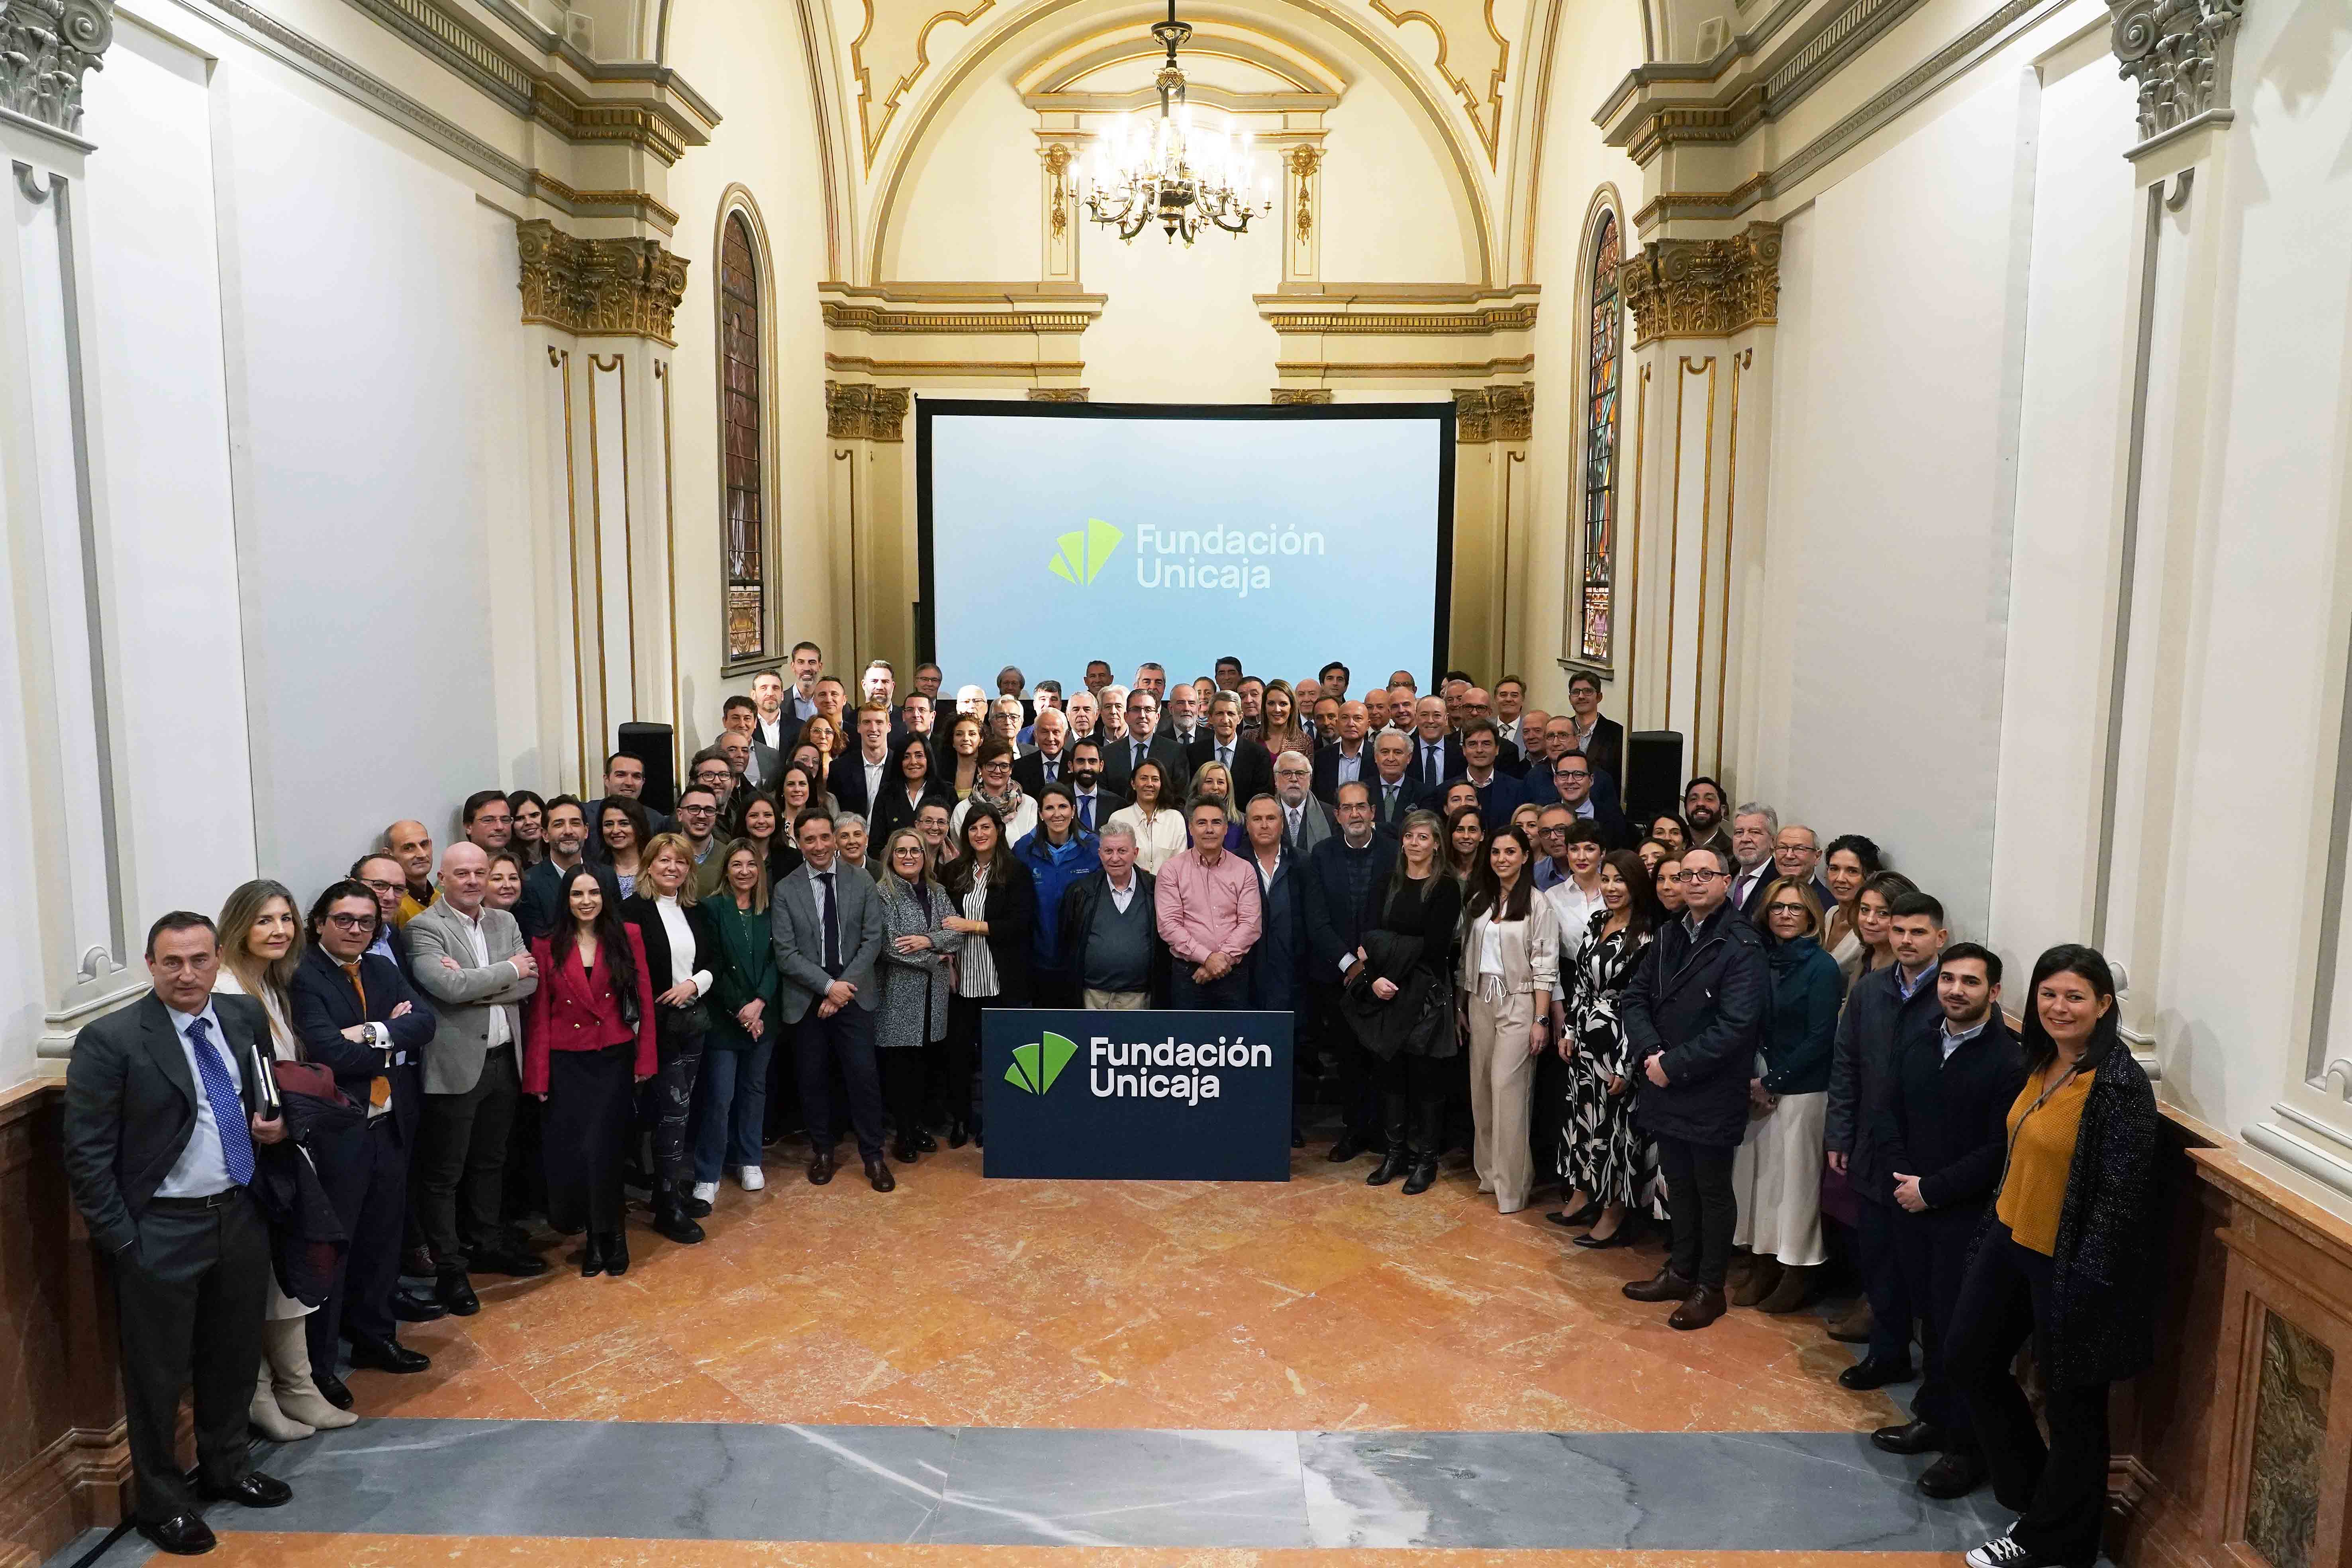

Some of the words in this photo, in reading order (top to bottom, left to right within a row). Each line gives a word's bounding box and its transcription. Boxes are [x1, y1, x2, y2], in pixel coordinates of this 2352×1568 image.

[1137, 523, 1324, 555] Fundación
[1137, 558, 1270, 598] Unicaja
[1091, 1037, 1271, 1067] Fundación
[1091, 1067, 1219, 1106] Unicaja
